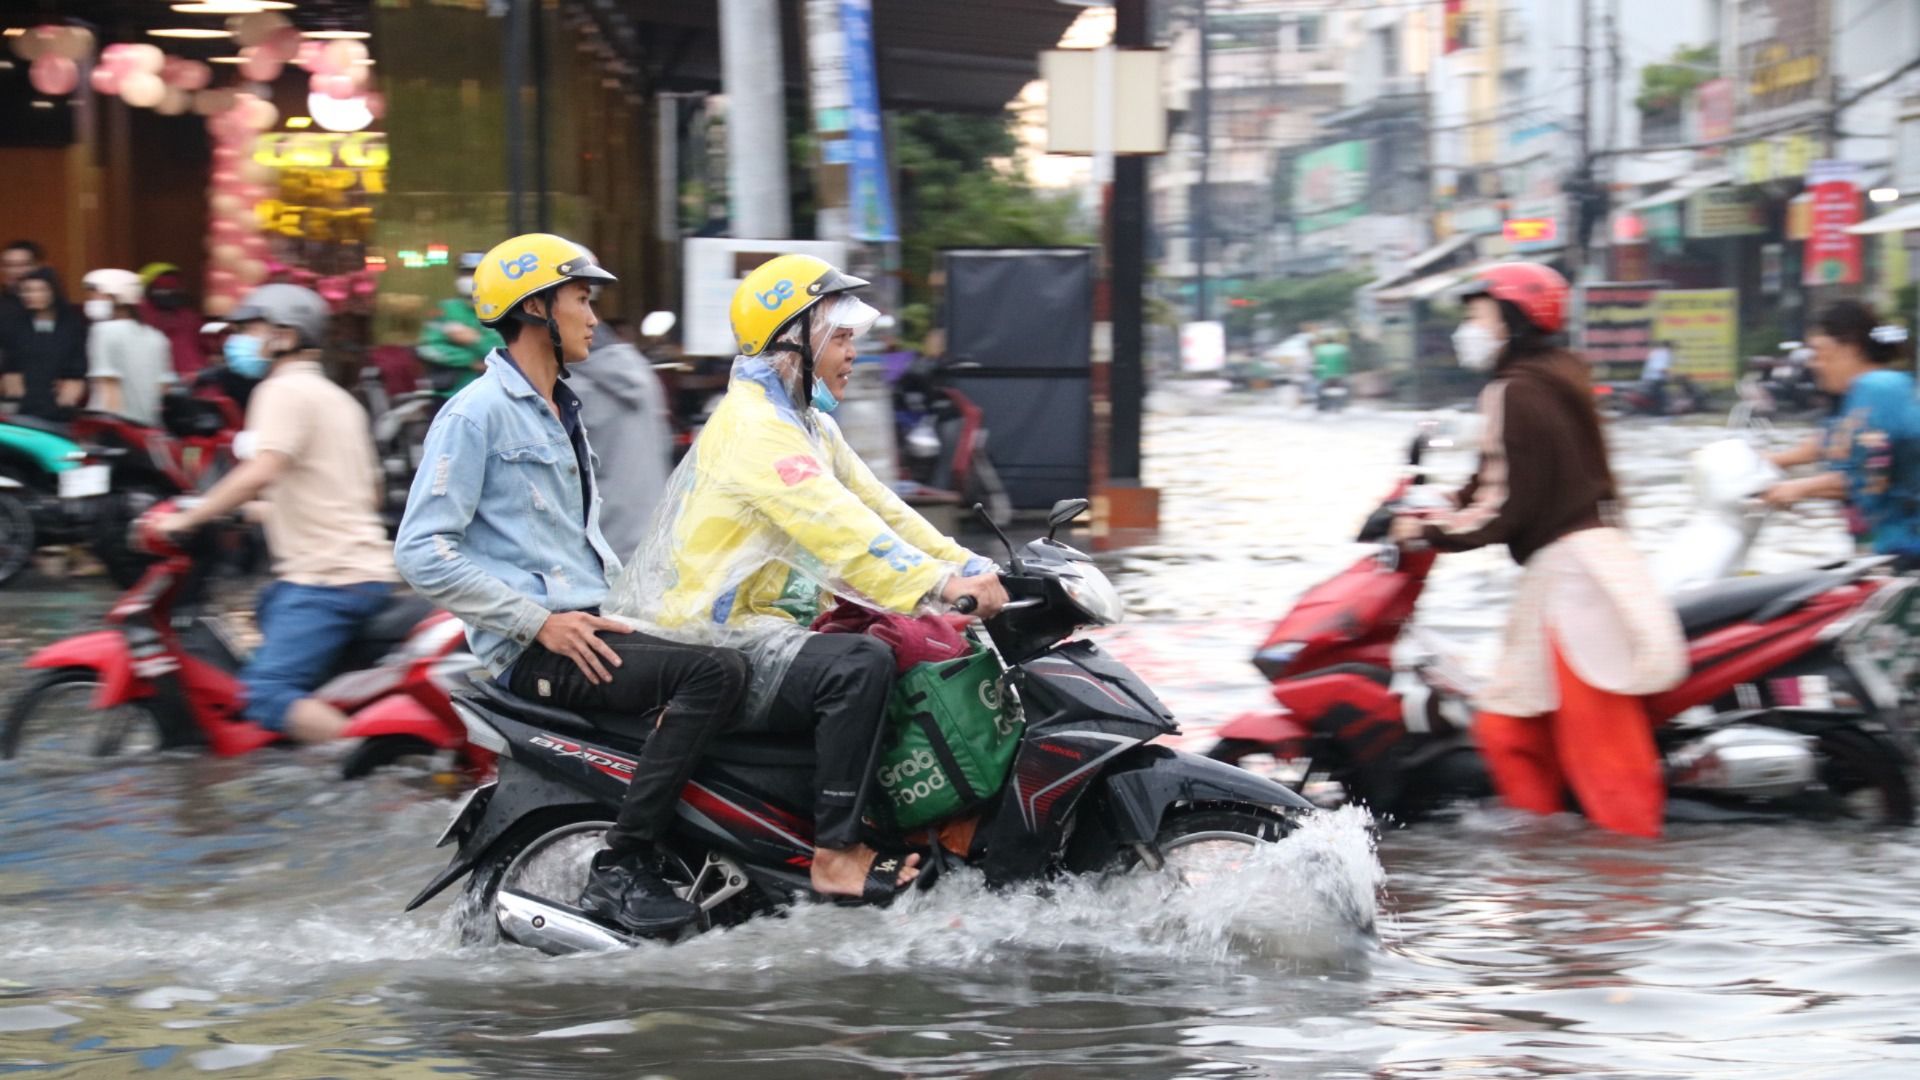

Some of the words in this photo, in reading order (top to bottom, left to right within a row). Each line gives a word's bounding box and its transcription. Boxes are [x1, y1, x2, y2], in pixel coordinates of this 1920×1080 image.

[499, 252, 539, 281] be
[755, 279, 795, 311] be
[528, 736, 637, 774] BLADE
[877, 748, 935, 788] Grab
